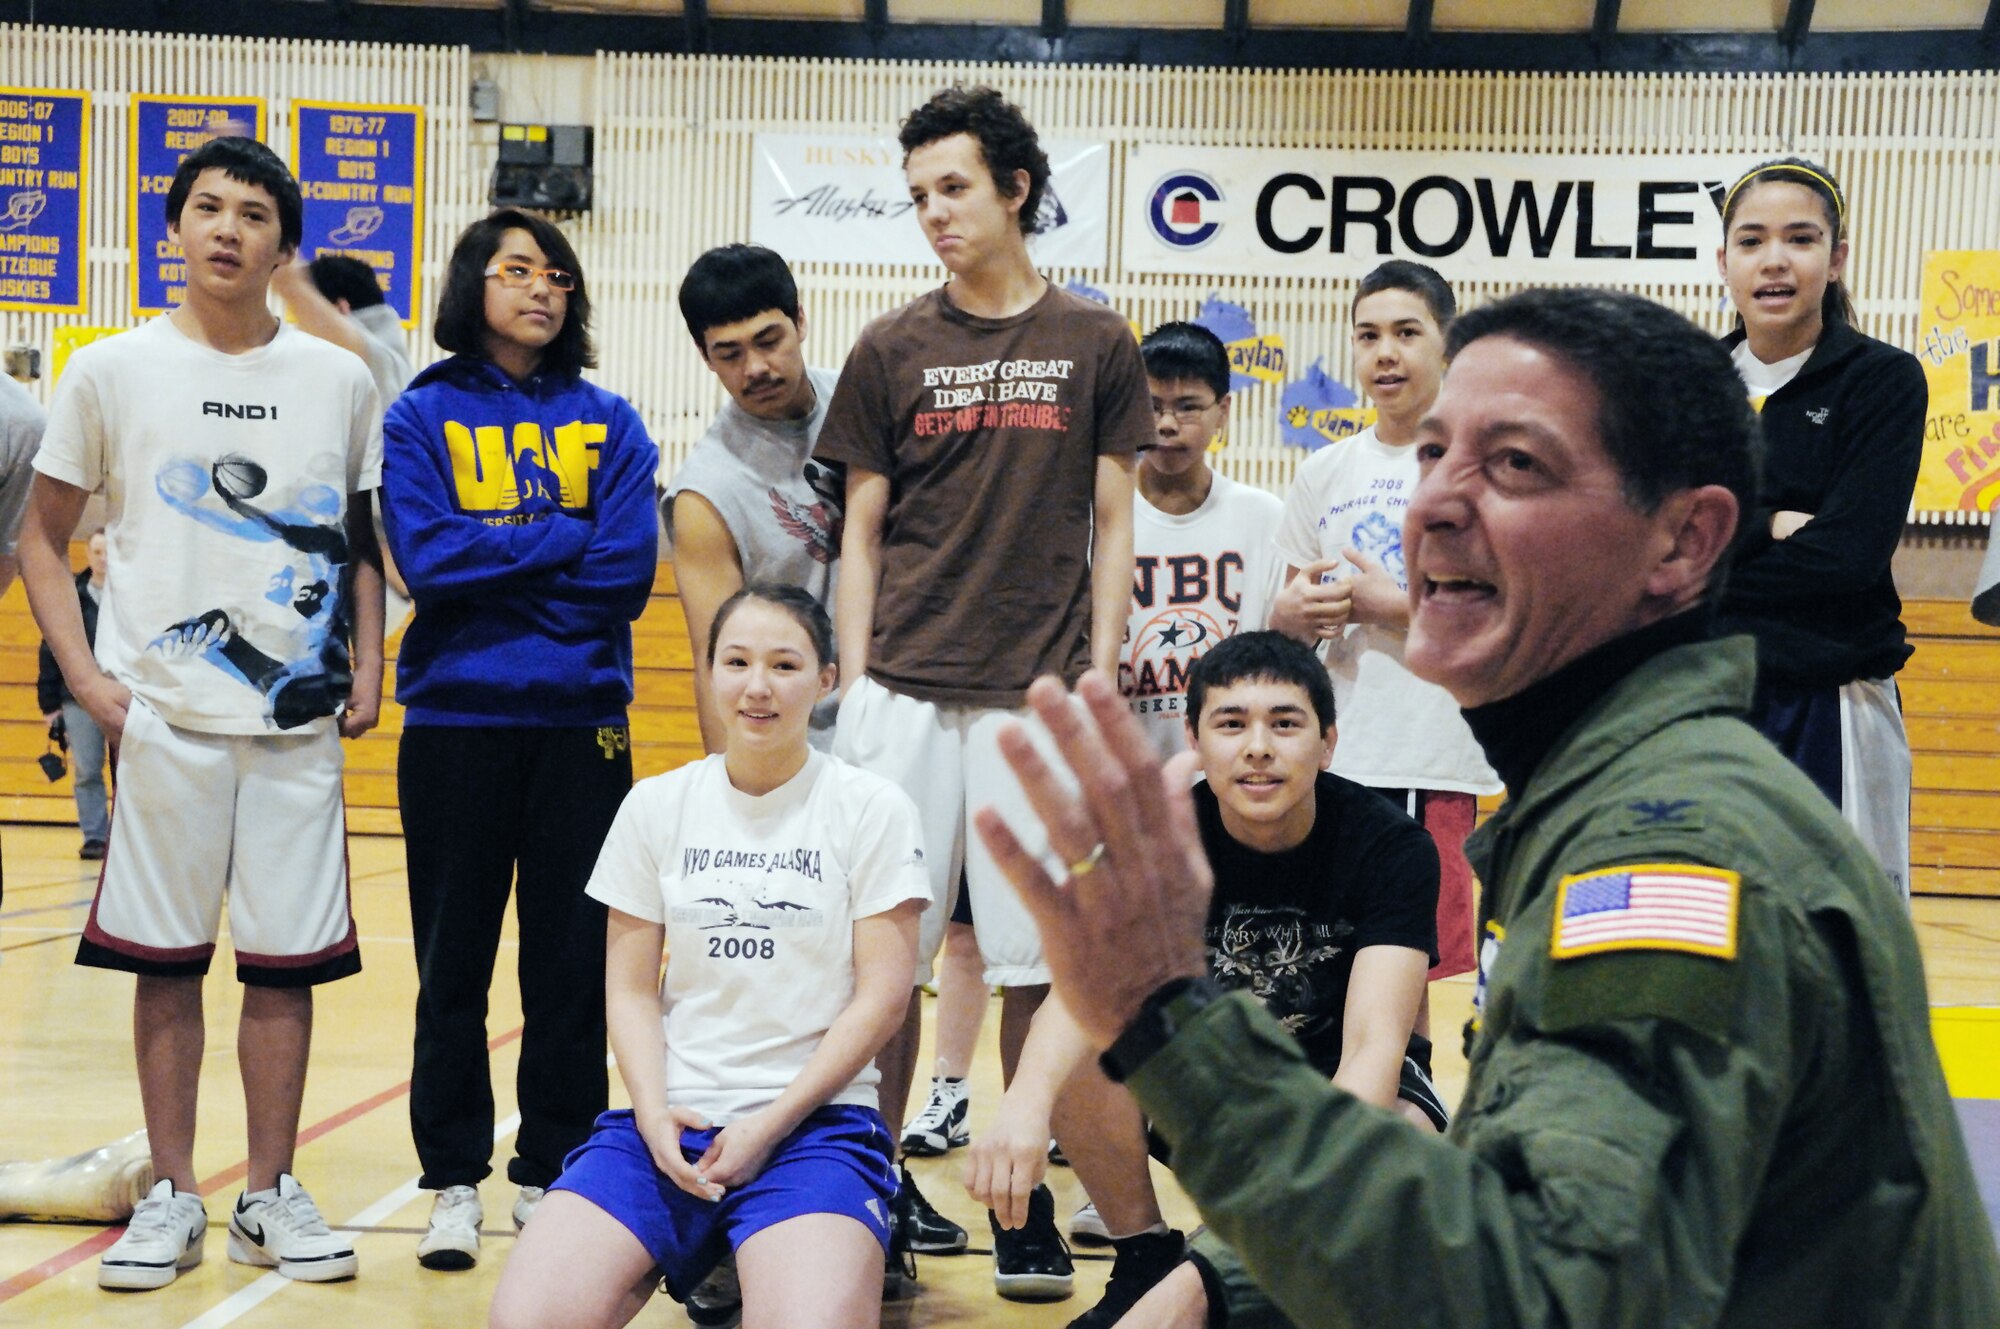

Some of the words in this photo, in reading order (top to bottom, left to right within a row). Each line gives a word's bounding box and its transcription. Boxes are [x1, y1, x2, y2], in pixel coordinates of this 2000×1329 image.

[0, 99, 54, 120] 006-07
[0, 122, 41, 142] EGION
[47, 125, 53, 143] 1
[329, 115, 386, 135] 1976-77
[1, 145, 40, 165] BOYS
[325, 137, 377, 157] REGION
[383, 140, 389, 158] 1
[47, 170, 77, 189] RUN
[337, 160, 375, 180] BOYS
[383, 185, 411, 204] RUN
[772, 184, 888, 222] Alaska
[0, 233, 59, 255] AMPIONS
[0, 256, 57, 277] TZEBUE
[0, 278, 50, 299] USKIES
[1226, 340, 1284, 372] aylan
[1920, 326, 1969, 366] the
[923, 360, 1000, 387] EVERY
[1000, 360, 1073, 380] GREAT
[933, 385, 985, 408] IDEA
[987, 383, 995, 402] I
[997, 381, 1058, 402] HAVE
[1925, 413, 1970, 441] are
[444, 420, 608, 511] UAF
[1371, 479, 1404, 490] 2008
[1117, 656, 1200, 698] CAM
[714, 849, 767, 869] GAMES
[769, 848, 823, 884] ALASKA
[708, 937, 775, 960] 2008
